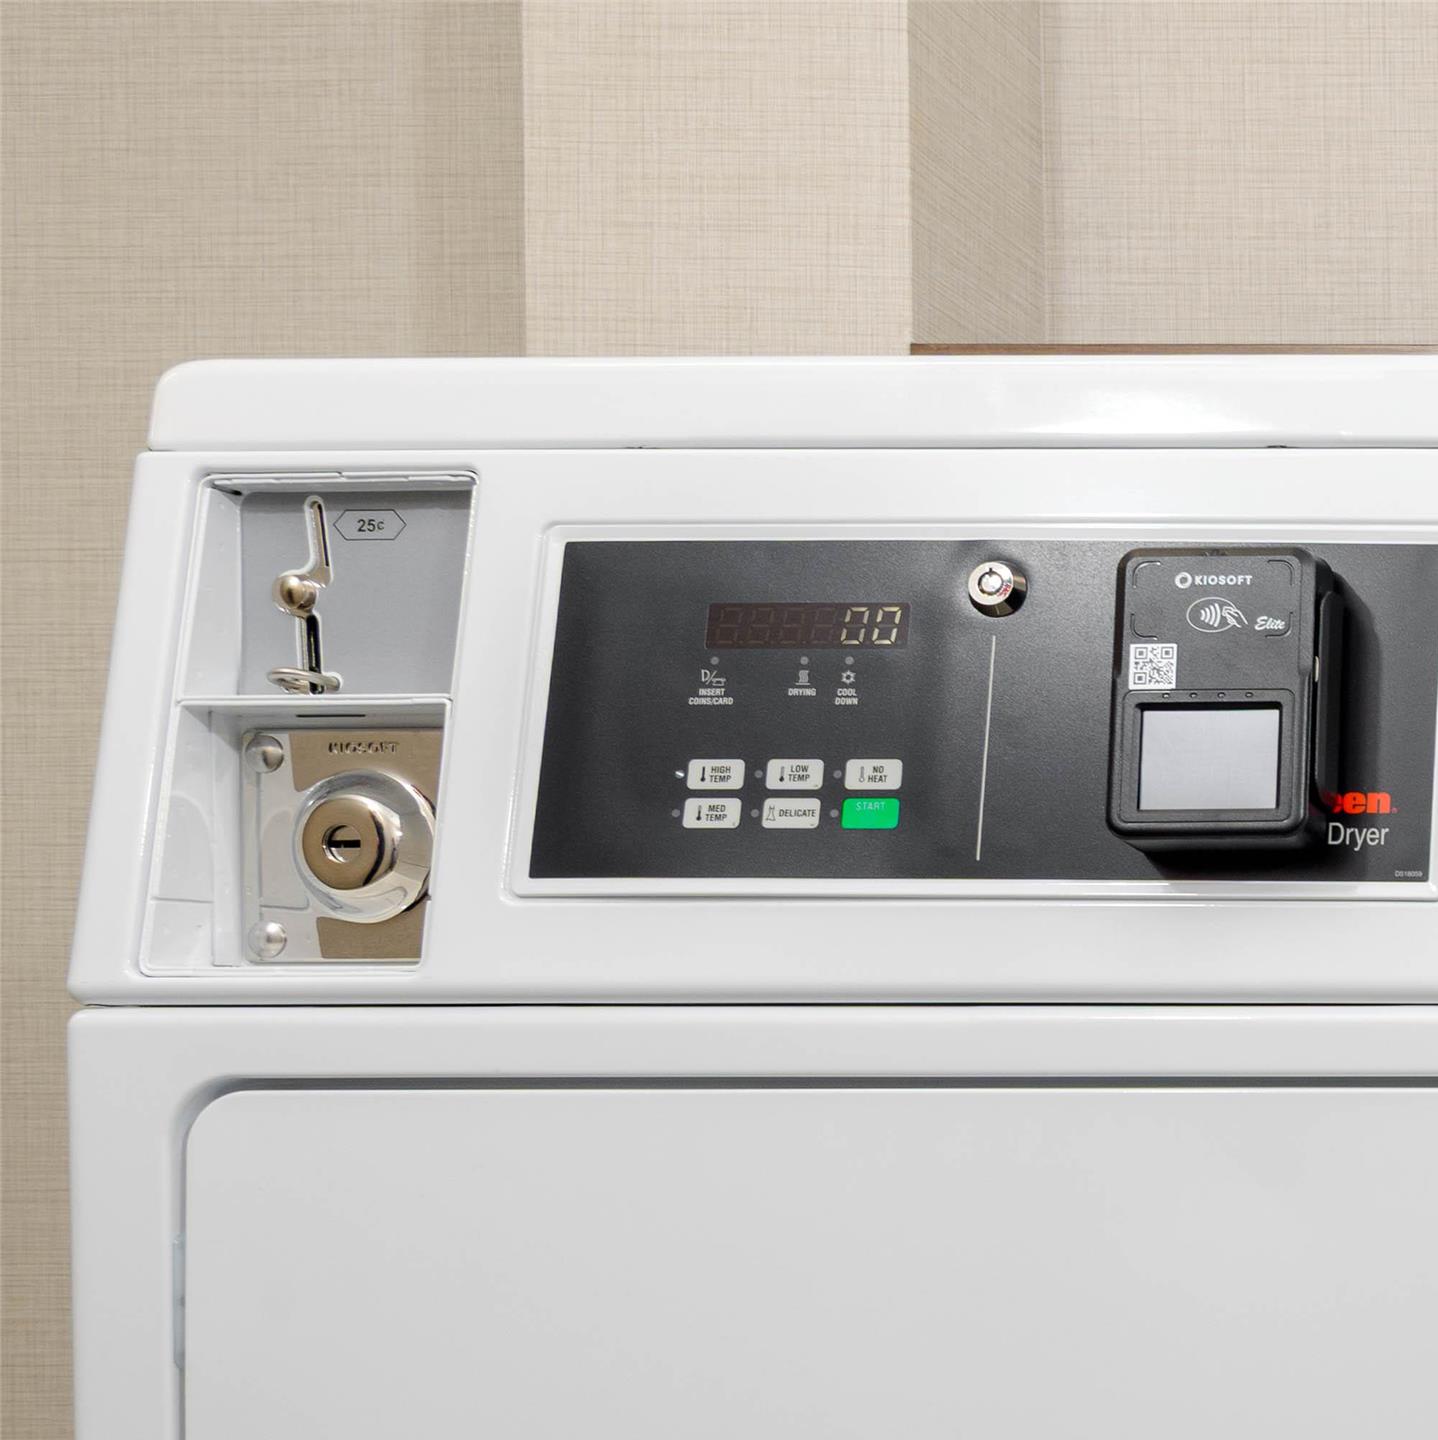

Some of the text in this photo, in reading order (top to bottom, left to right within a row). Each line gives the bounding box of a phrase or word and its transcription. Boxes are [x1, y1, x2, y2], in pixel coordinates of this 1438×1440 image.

[1194, 575, 1253, 585] KIOSOFT
[1254, 615, 1286, 631] Elite
[698, 688, 726, 697] INSERT
[787, 688, 817, 697] DRYING
[836, 688, 857, 697] COOL
[834, 697, 859, 706] DOWN
[710, 765, 731, 774] HIGH
[790, 764, 809, 774] LOW
[872, 765, 885, 774] NO
[709, 774, 732, 783] TEMP
[788, 774, 810, 783] TEMP
[867, 774, 888, 783] HEAT
[707, 804, 726, 813] MED
[855, 801, 886, 812] START
[705, 813, 728, 822] TEMP
[778, 808, 817, 818] DELICATE
[1327, 822, 1390, 851] Dryer
